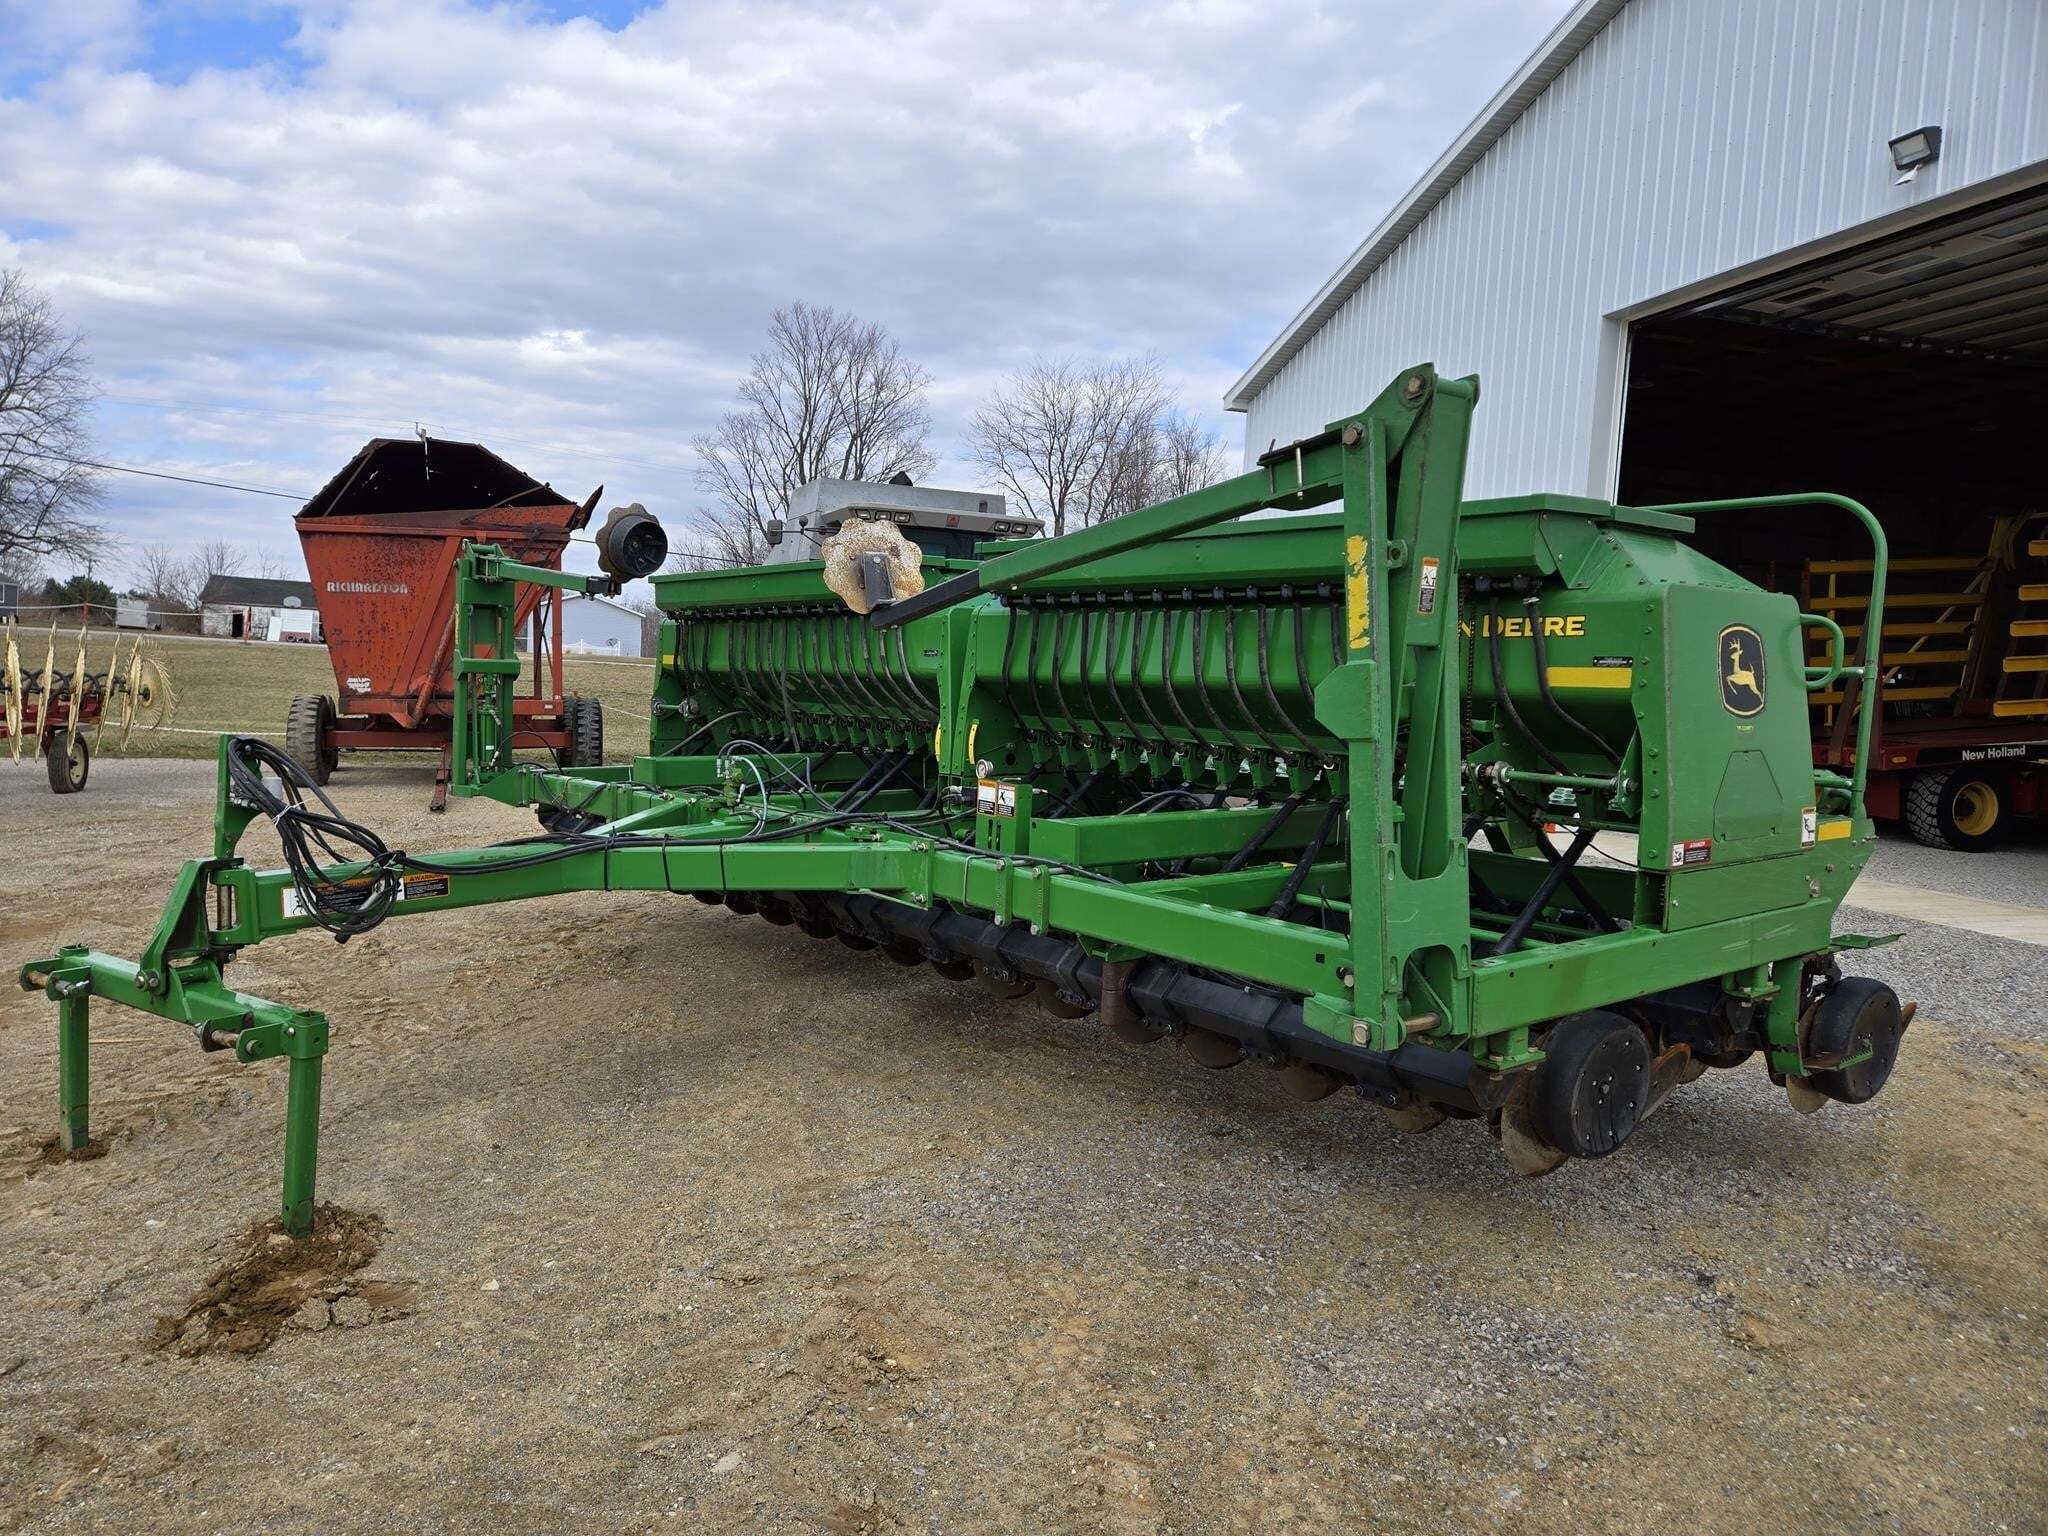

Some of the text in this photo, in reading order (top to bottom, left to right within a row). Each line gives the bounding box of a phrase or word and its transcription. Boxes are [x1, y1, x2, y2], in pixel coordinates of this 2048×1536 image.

[1482, 615, 1586, 637] DEERE
[1962, 745, 2026, 761] New Holland
